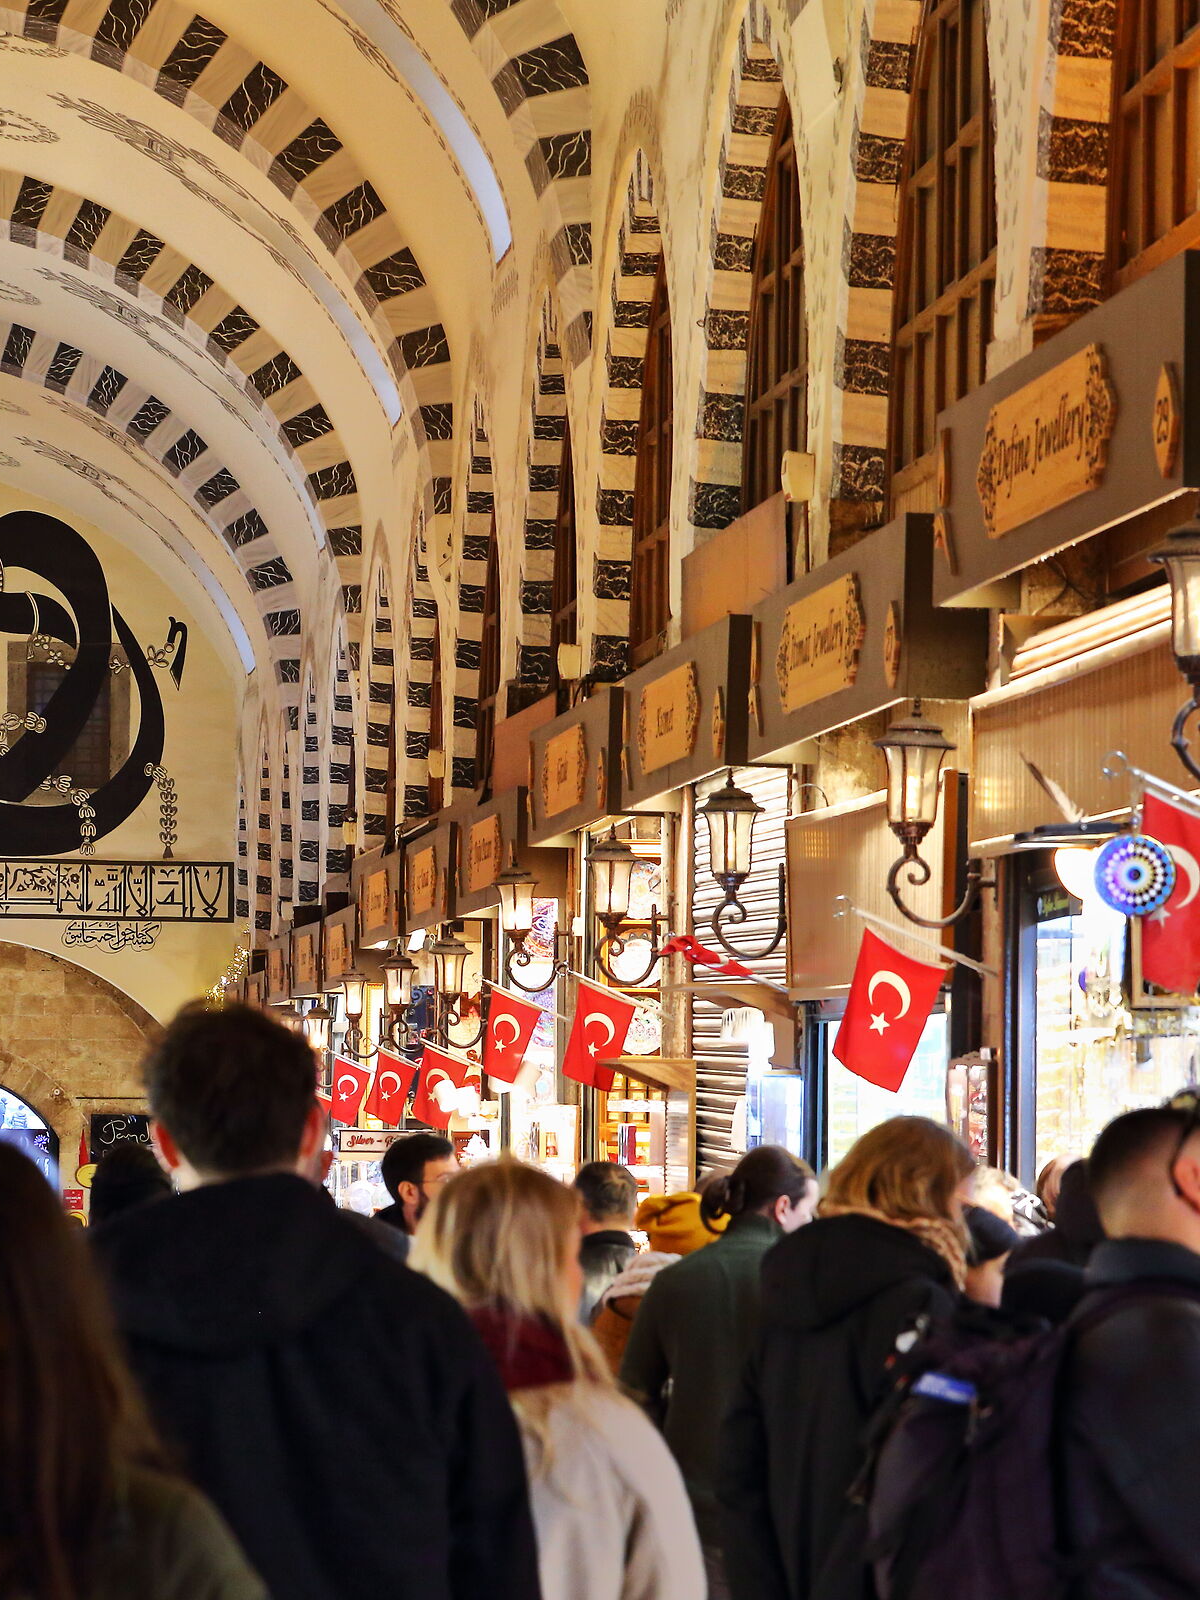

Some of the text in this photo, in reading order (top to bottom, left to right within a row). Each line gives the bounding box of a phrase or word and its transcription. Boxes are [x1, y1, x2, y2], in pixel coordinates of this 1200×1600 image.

[996, 392, 1085, 499] Define Jewellery
[99, 1118, 151, 1145] Pand
[346, 1134, 375, 1148] Silver
